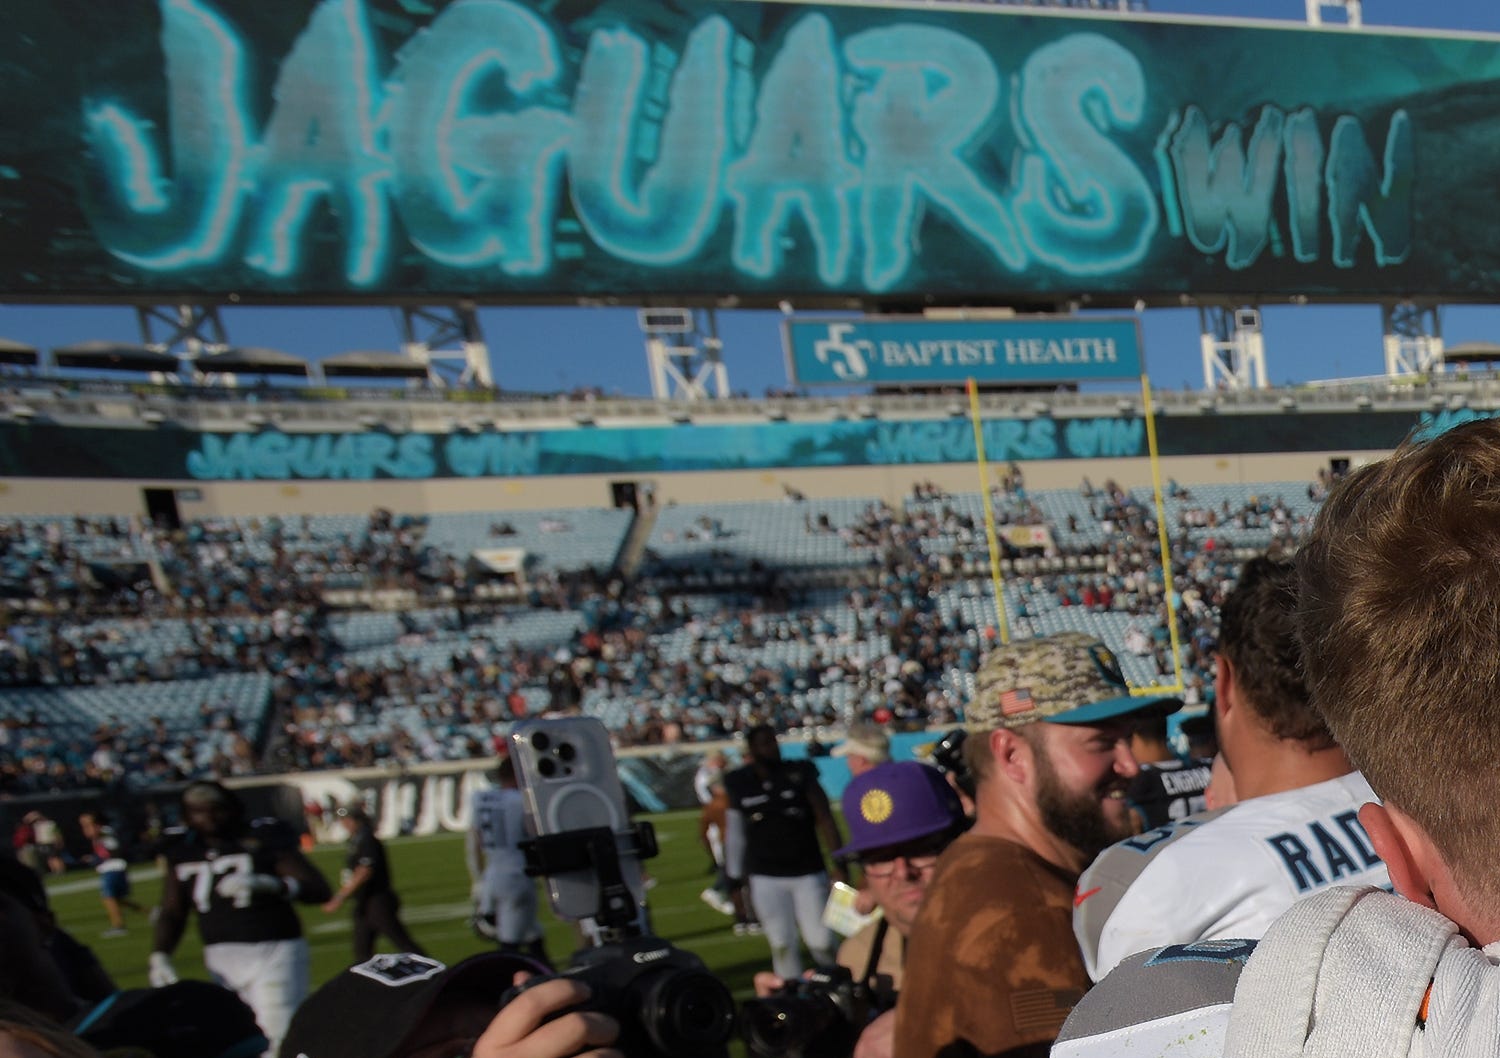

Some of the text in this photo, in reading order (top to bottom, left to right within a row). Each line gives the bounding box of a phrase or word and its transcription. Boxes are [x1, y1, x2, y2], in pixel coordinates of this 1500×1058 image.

[83, 0, 1413, 287] JAGUARS WIN
[883, 338, 1118, 367] BAPTIST HEALTH
[186, 432, 538, 480] JAGUARS WIN
[865, 418, 1143, 463] JAGUARS WIN
[633, 948, 671, 964] Canon
